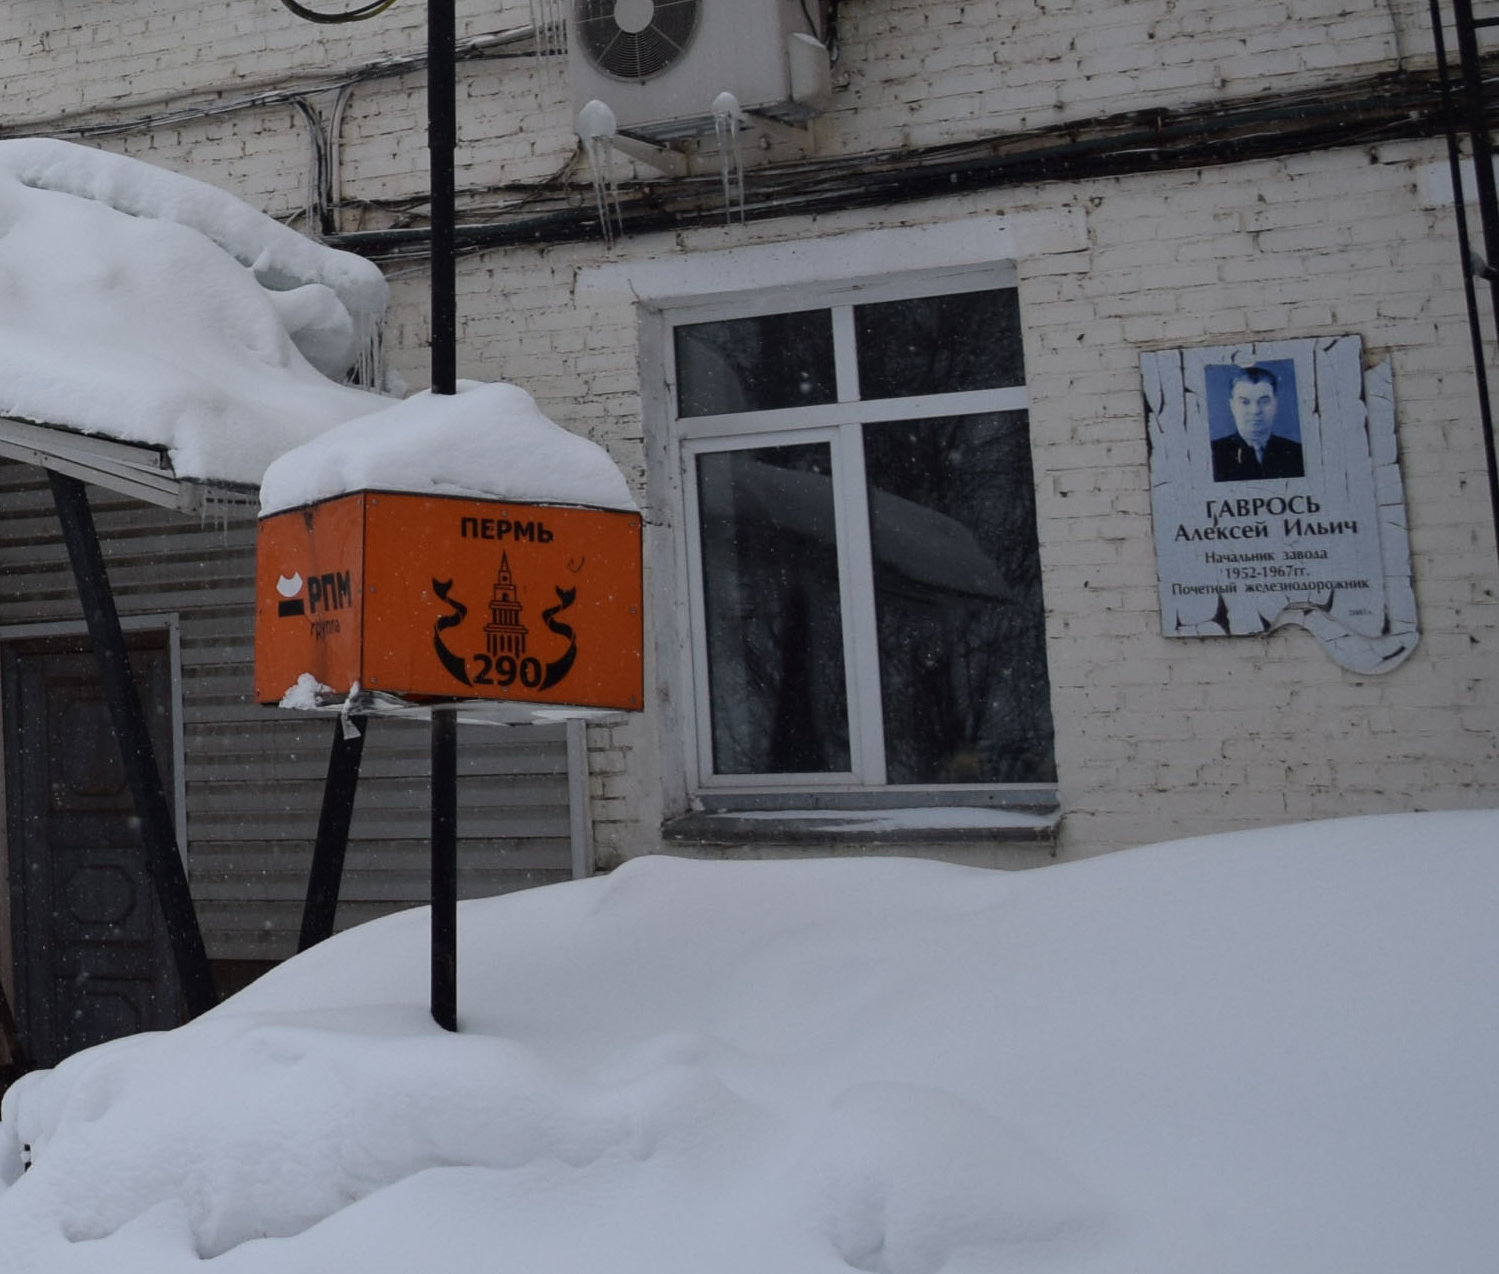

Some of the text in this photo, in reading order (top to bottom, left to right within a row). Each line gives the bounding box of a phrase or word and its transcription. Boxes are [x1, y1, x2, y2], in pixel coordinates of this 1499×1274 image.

[1206, 495, 1320, 518] ГАВРОСЬ
[461, 516, 553, 543] ПЕРМЬ
[1175, 518, 1358, 542] Алексей Ильич
[1205, 550, 1328, 564] Начальник завода
[1225, 565, 1310, 579] 1952-1967гг.
[308, 570, 351, 614] РПМ
[1172, 578, 1369, 595] Почетный железнодорожник
[473, 654, 542, 688] 290
